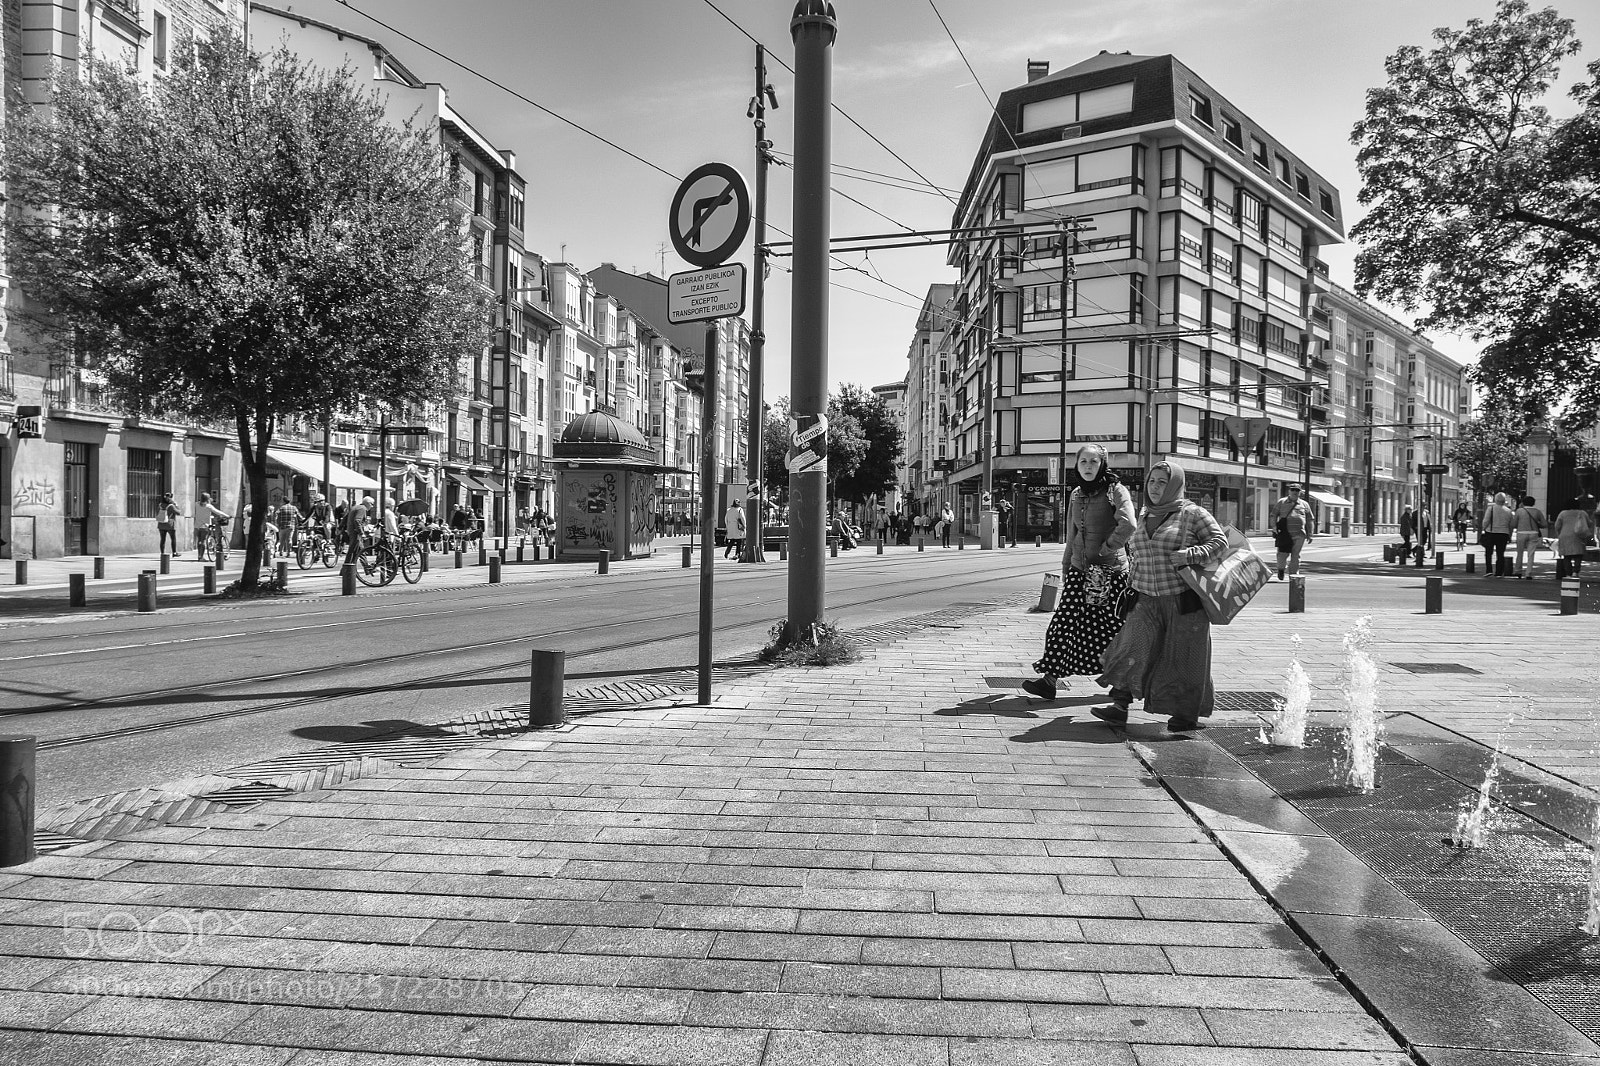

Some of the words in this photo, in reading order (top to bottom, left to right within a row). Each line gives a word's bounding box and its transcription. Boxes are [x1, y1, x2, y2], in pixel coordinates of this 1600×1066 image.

[676, 275, 704, 286] GARRAIO
[704, 270, 736, 281] PUBLIKOA
[690, 284, 705, 292] IZAN
[705, 281, 720, 290] EZIK
[691, 295, 719, 306] EXCEPTO
[672, 306, 711, 318] TRANSPORTE
[711, 301, 739, 312] PUBLICO
[20, 418, 39, 432] 24h
[801, 441, 811, 449] de
